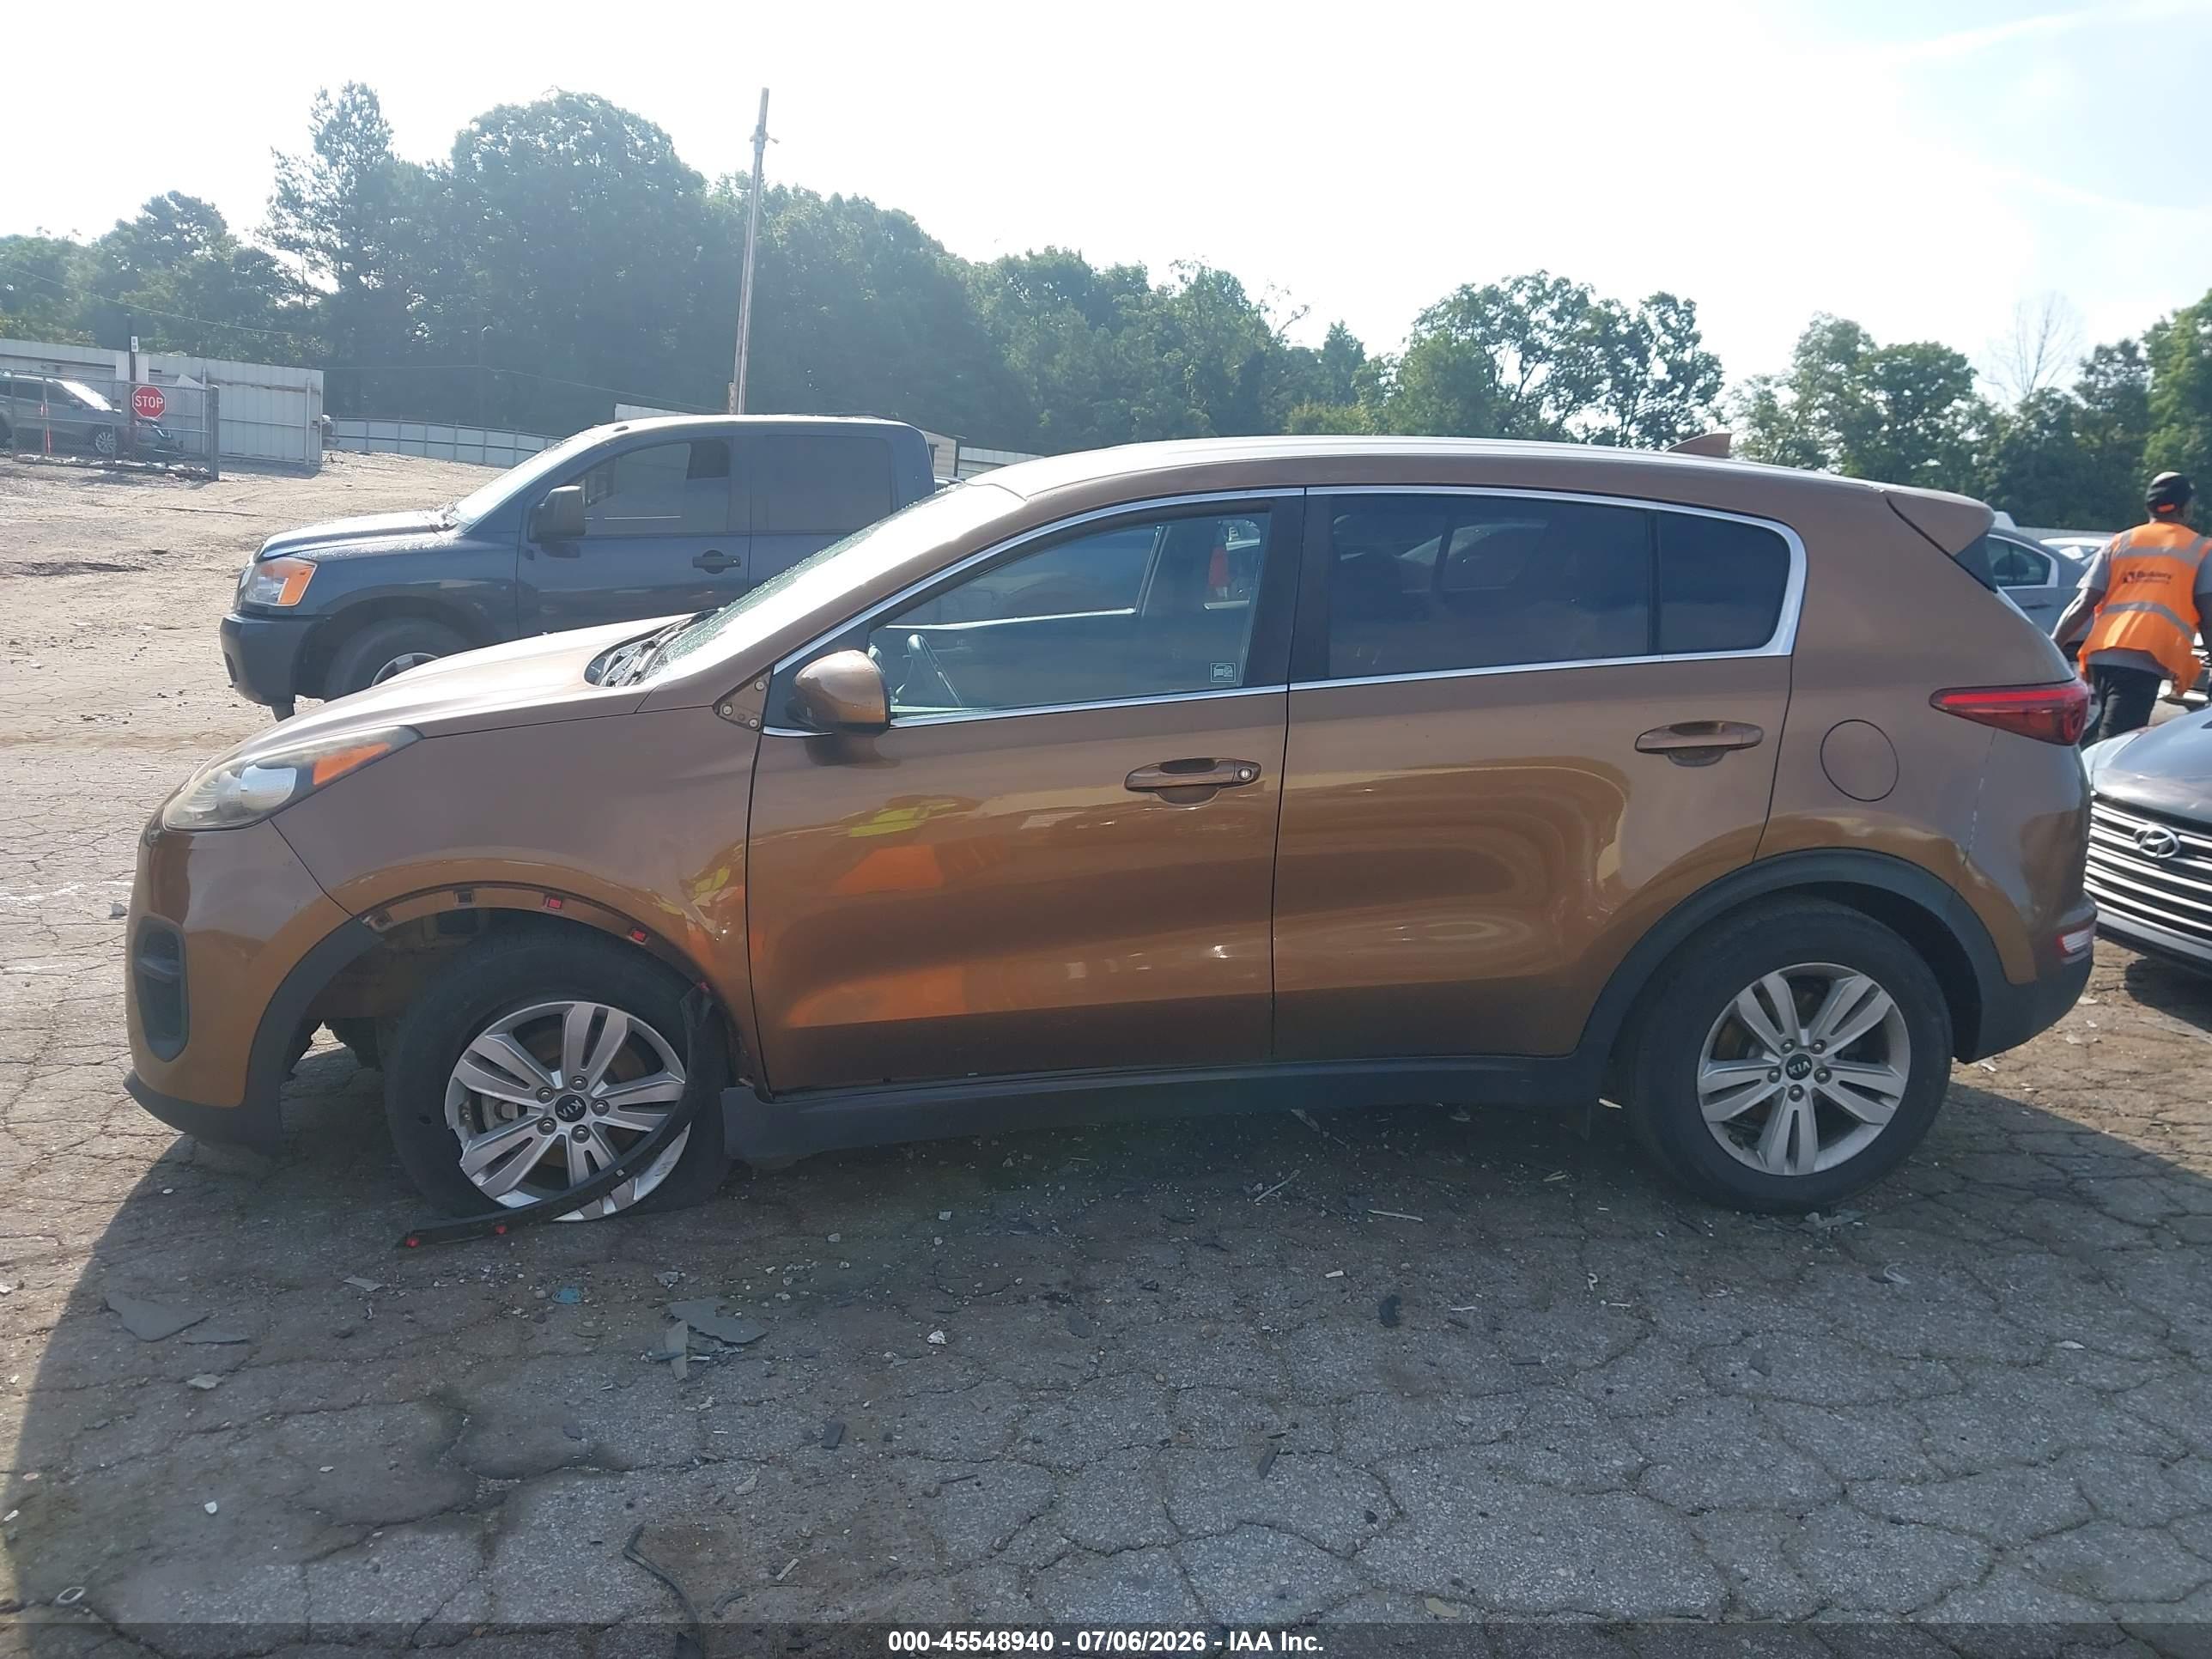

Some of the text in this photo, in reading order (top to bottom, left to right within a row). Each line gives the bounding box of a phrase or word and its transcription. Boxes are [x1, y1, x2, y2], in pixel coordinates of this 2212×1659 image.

[135, 395, 164, 409] STOP
[1788, 1060, 1811, 1075] KIA
[557, 1099, 583, 1118] KIA
